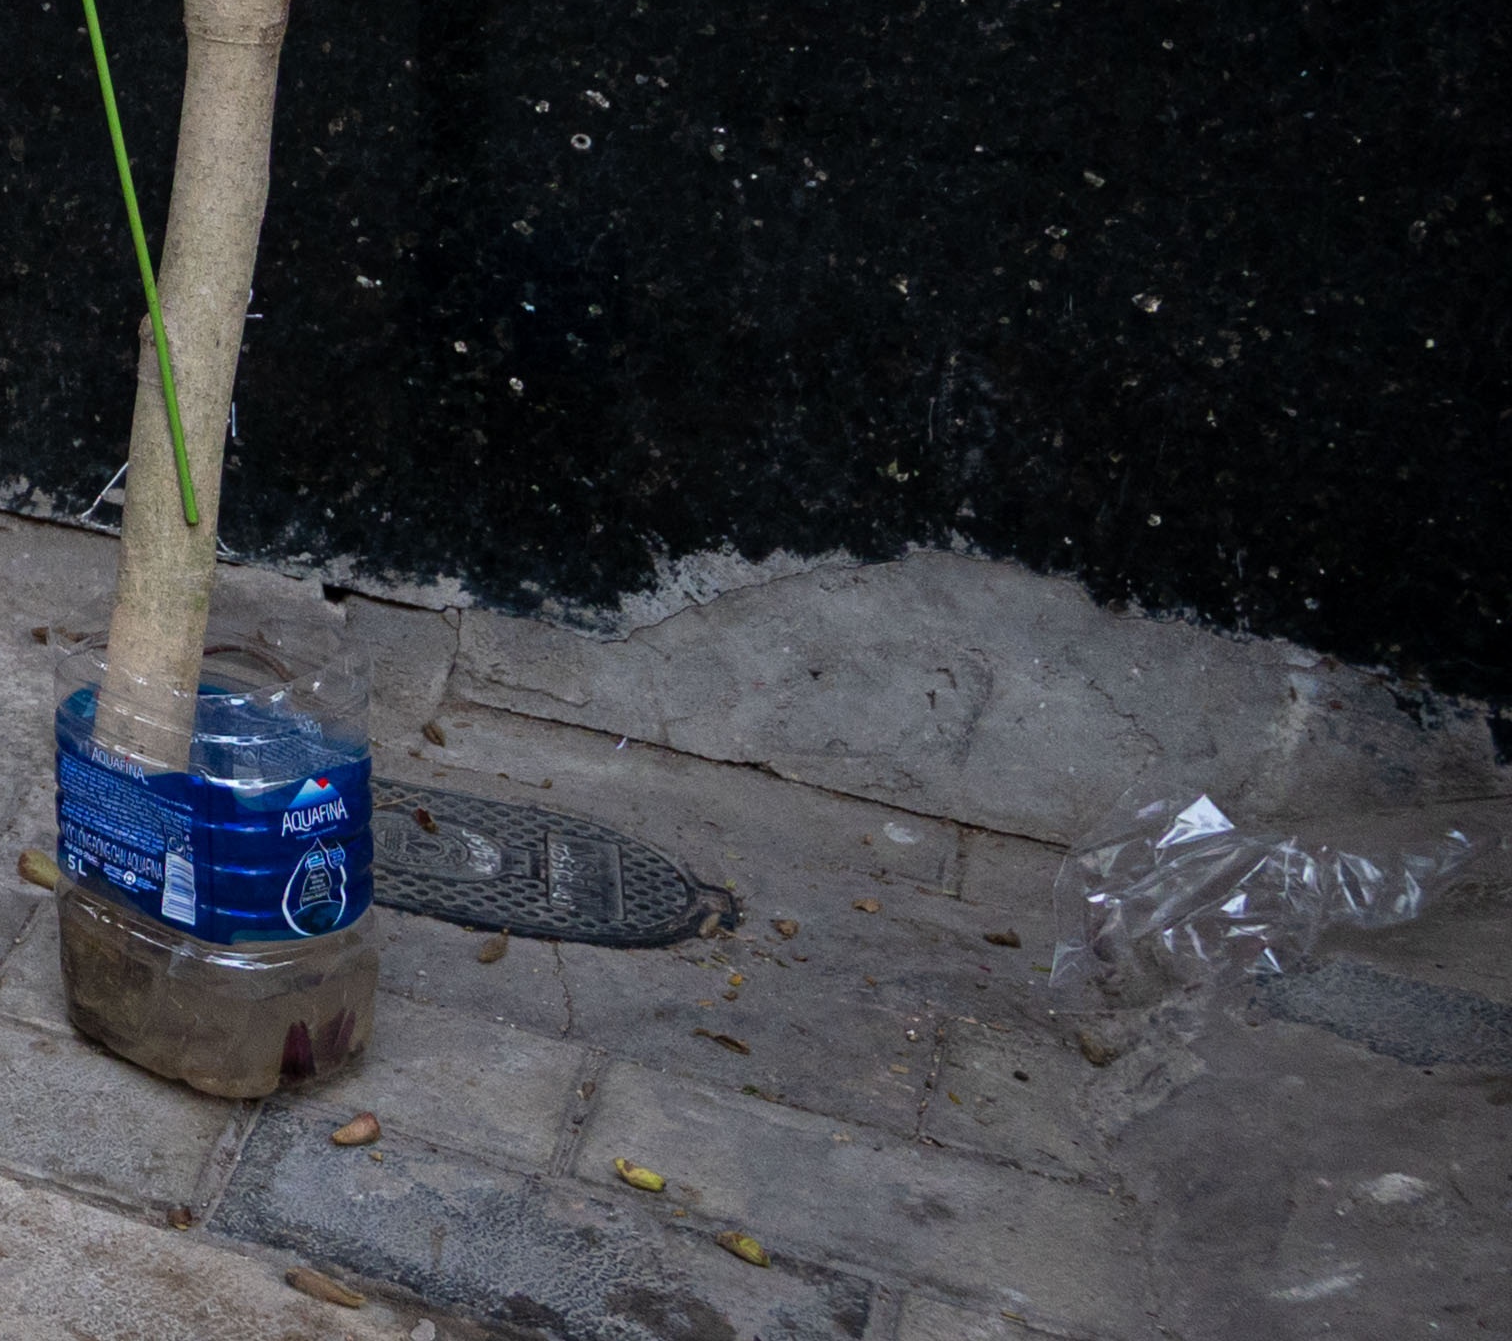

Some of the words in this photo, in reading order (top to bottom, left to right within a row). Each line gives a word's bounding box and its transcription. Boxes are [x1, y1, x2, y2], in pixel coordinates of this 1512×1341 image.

[91, 747, 149, 786] AQUAFINA
[280, 797, 349, 838] AQUAFINA
[67, 853, 76, 870] 5
[78, 859, 88, 877] L
